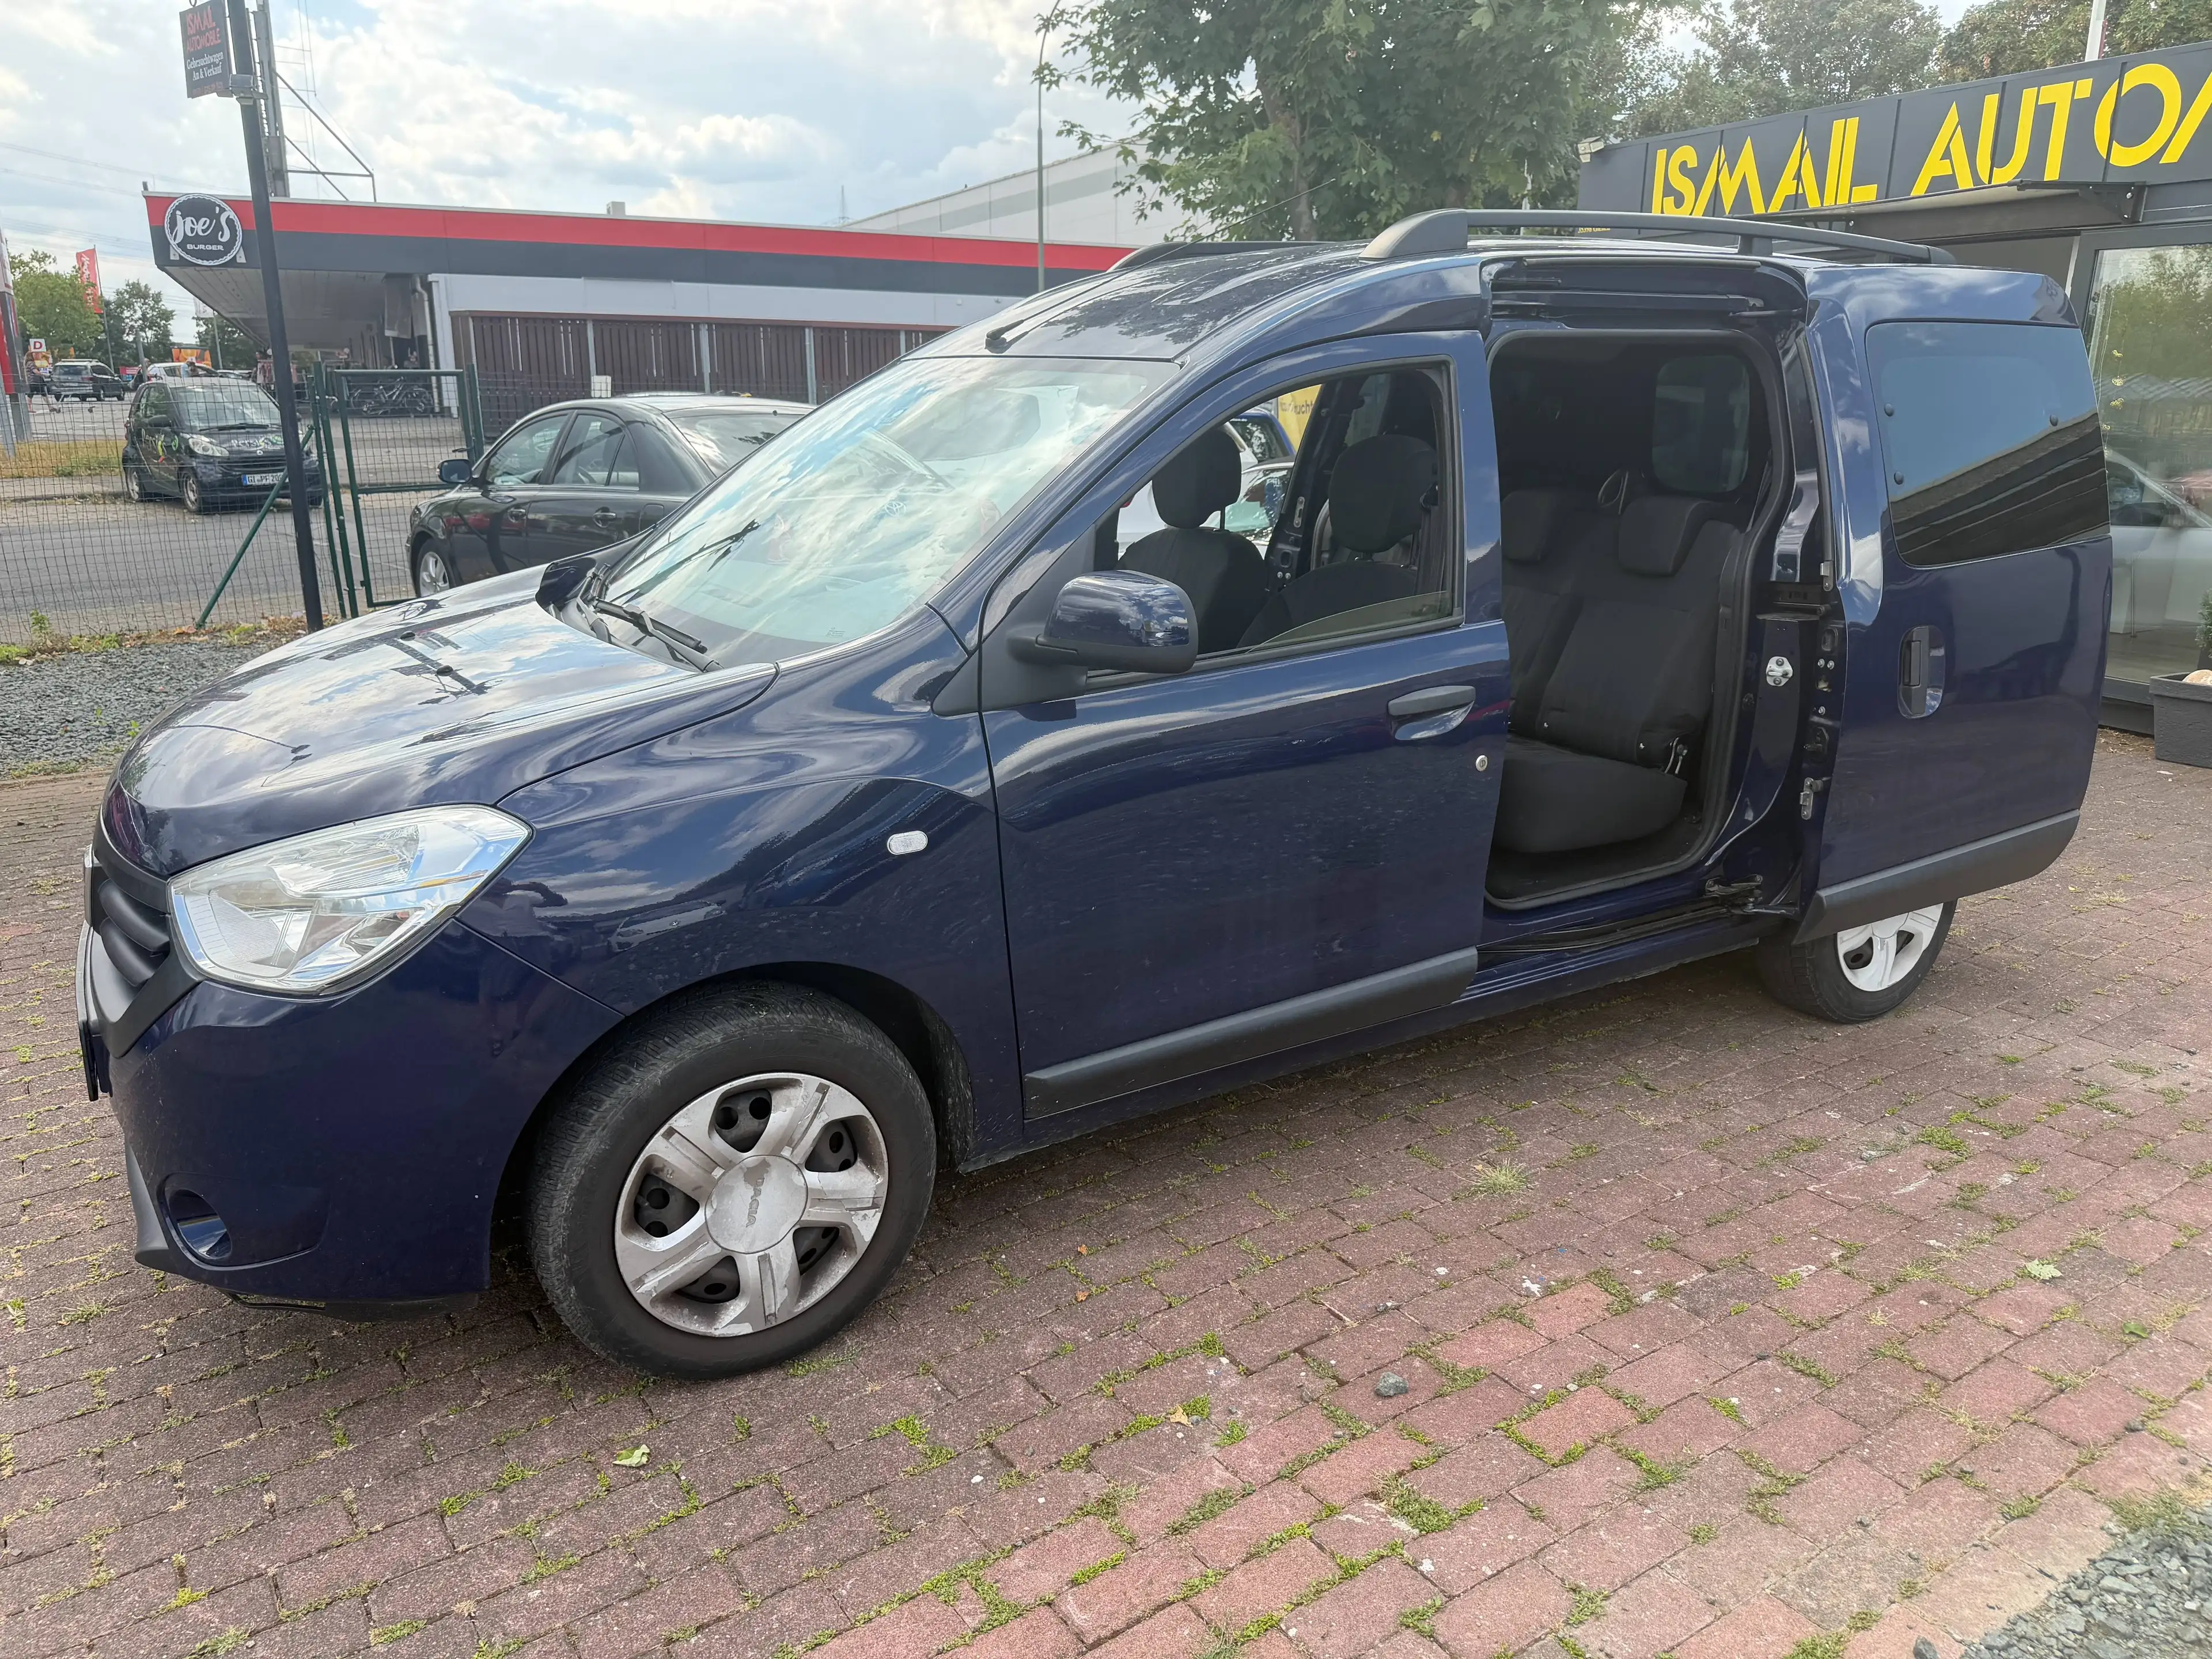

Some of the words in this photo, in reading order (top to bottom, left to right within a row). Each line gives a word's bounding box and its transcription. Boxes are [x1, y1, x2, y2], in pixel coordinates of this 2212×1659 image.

[187, 51, 224, 70] Gebrauchtwagen
[192, 70, 200, 81] An
[199, 68, 205, 78] &
[204, 62, 222, 78] Verkauf
[1652, 116, 1878, 217] ISMAIL
[1910, 63, 2212, 196] AUTO
[33, 340, 43, 350] D
[746, 1176, 765, 1228] DACIA
